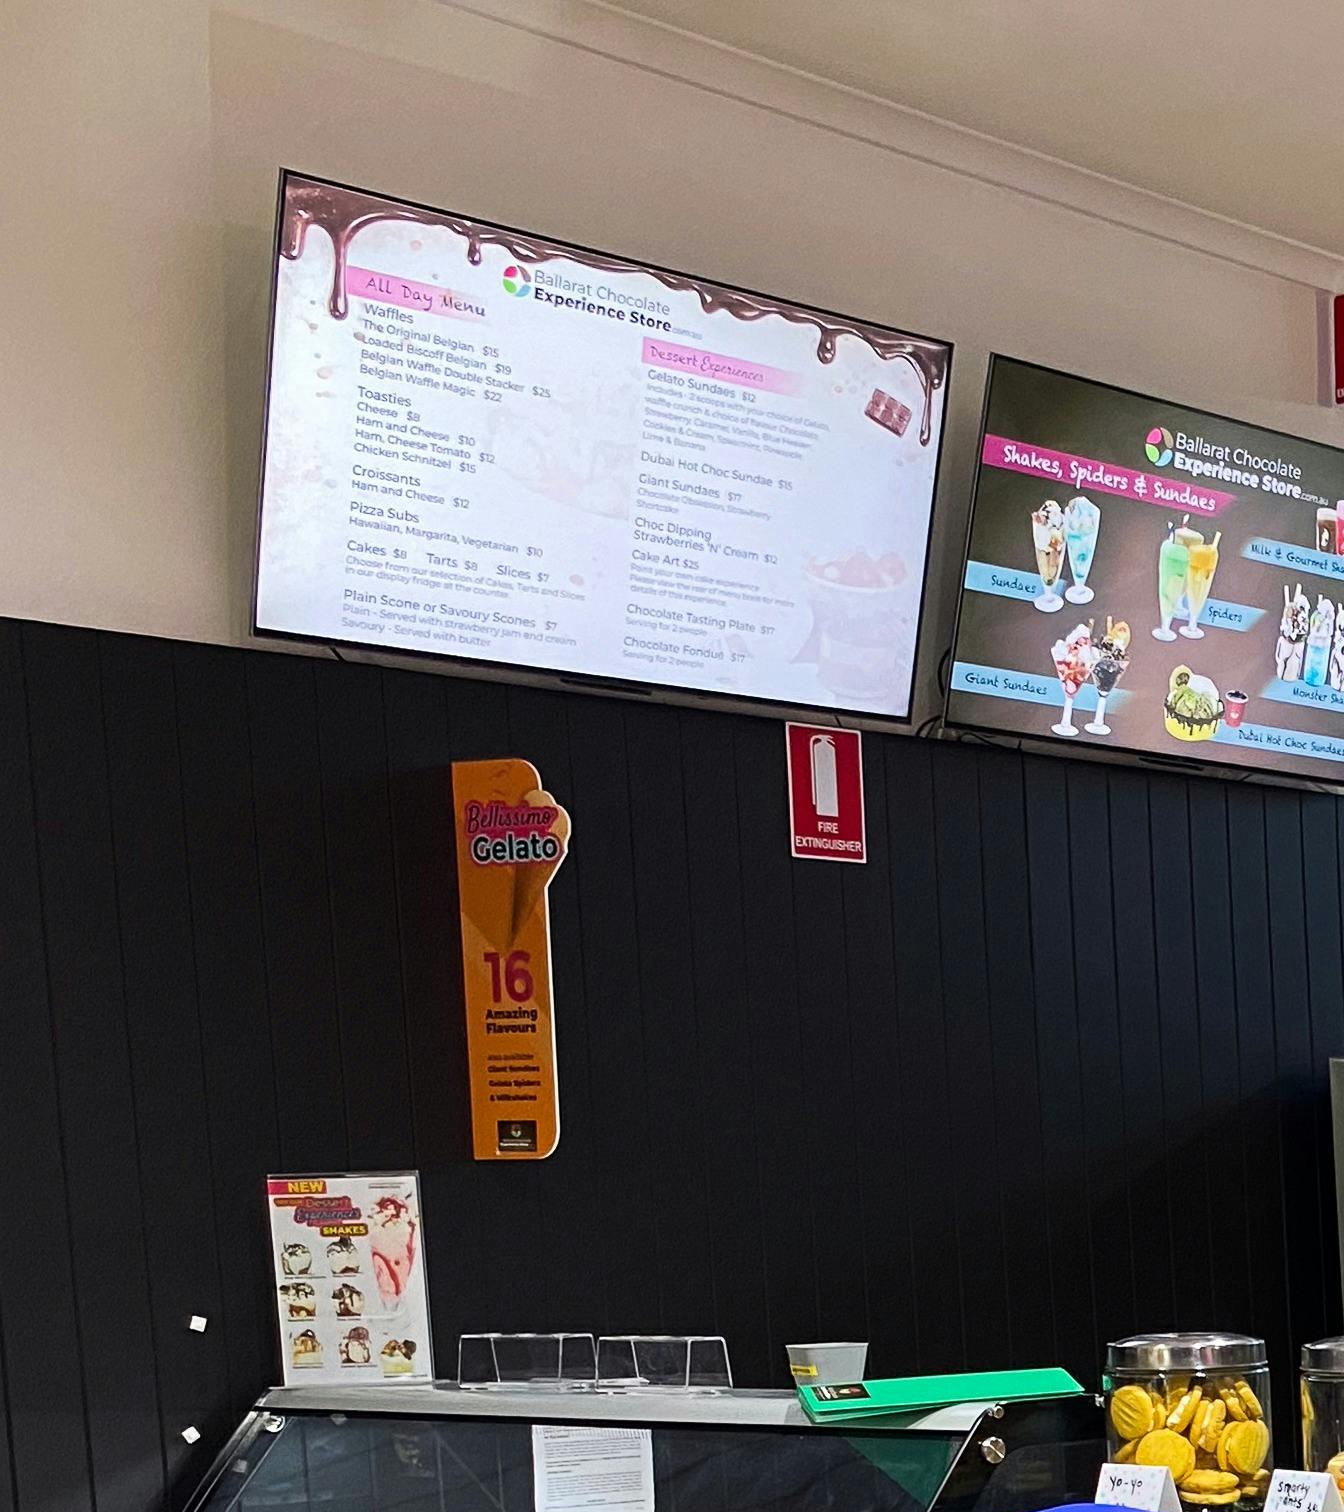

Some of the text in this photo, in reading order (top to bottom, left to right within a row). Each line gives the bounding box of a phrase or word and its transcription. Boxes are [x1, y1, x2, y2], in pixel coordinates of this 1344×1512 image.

[365, 277, 486, 317] All Day Menu
[364, 303, 414, 324] Waffles
[650, 346, 764, 384] Dessert Experiences
[358, 386, 412, 407] Toasties
[1175, 431, 1302, 480] Ballarat Chocolate
[352, 465, 421, 487] Croissants
[641, 451, 773, 487] Dubai Hot Choc Sundae
[1003, 444, 1216, 512] Shakes, Spiders & Sundaes
[1173, 451, 1259, 489] Experience
[350, 501, 419, 523] Pizza Subs
[991, 575, 1037, 594] Sundaes
[344, 589, 536, 628] Plain Scone or Savoury Scones
[1207, 605, 1242, 623] Spiders
[467, 804, 554, 834] Bellissimo
[818, 821, 839, 834] FIRE
[471, 834, 559, 863] Gelato
[795, 836, 861, 852] EXTINGUISHER
[483, 950, 534, 1003] 16
[485, 1007, 538, 1022] Amazing
[486, 1022, 538, 1036] Flavours
